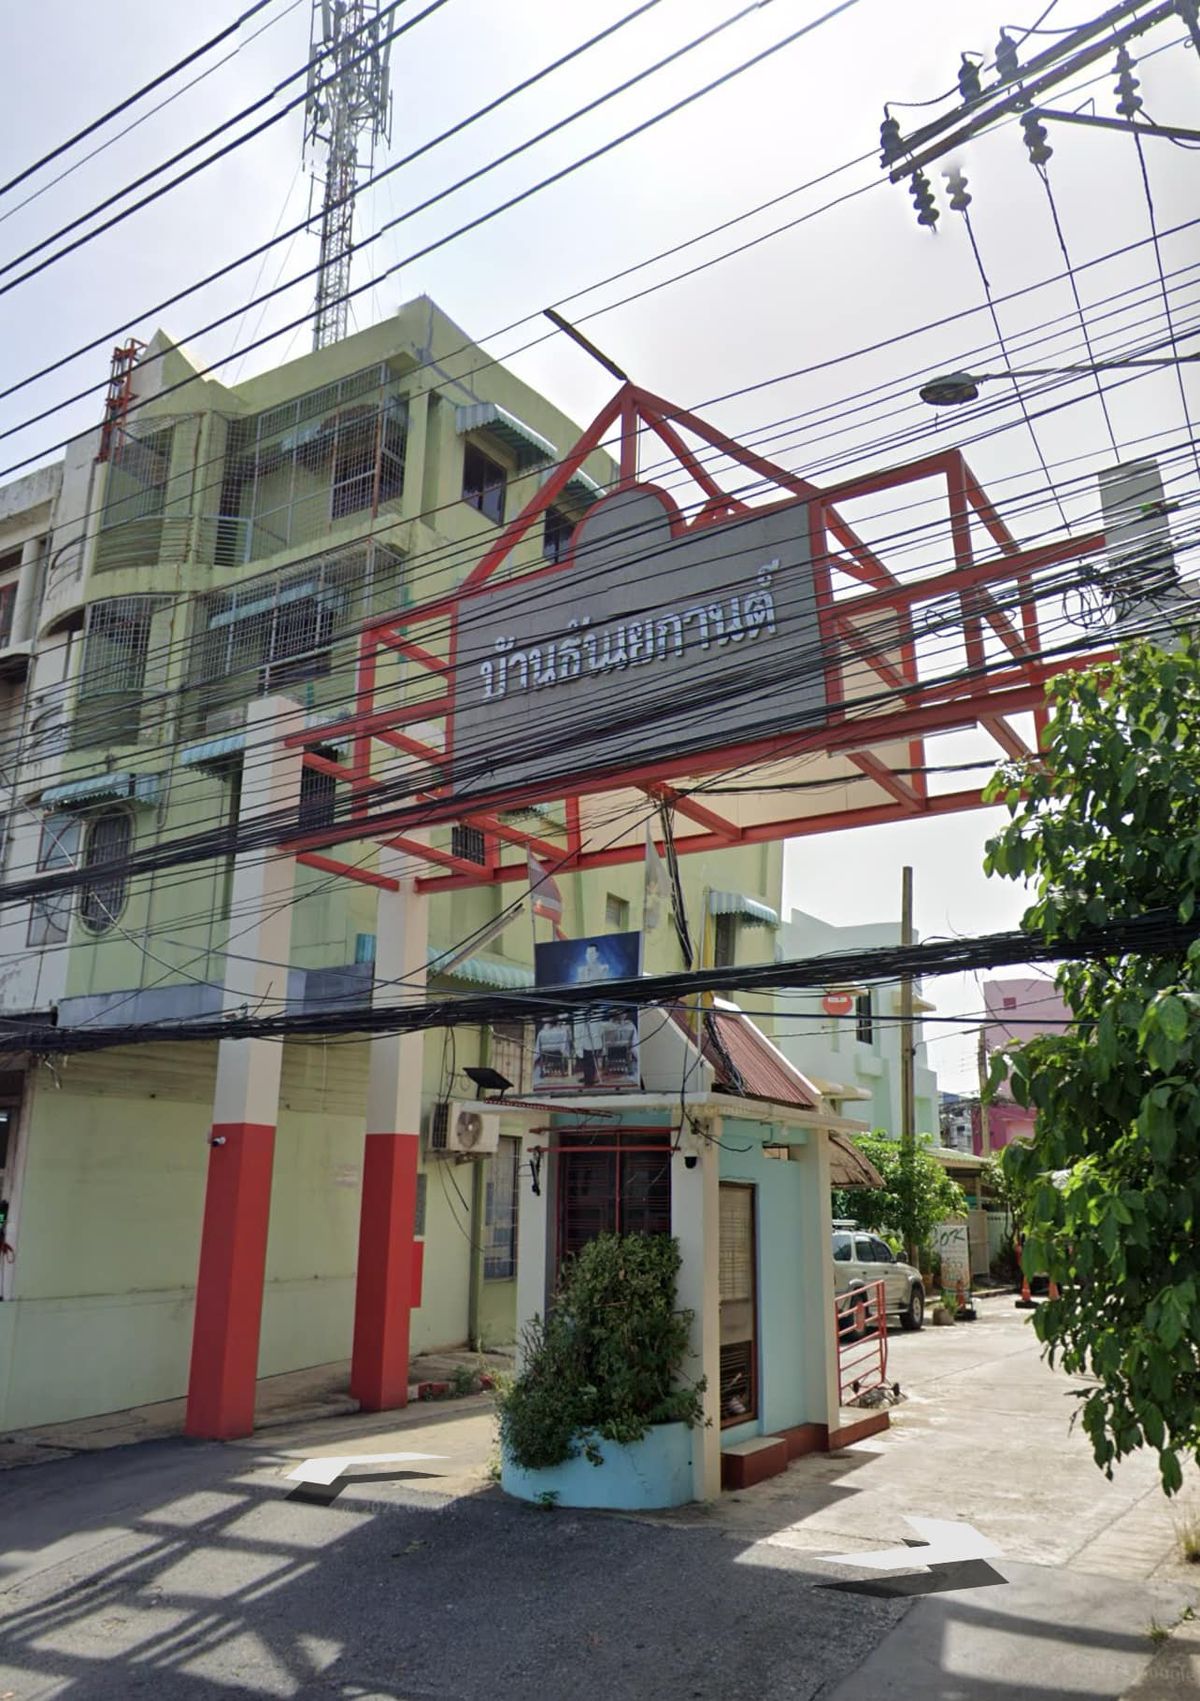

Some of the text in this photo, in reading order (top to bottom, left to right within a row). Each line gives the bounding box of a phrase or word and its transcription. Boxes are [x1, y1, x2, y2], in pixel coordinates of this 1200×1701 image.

[480, 558, 780, 703] บ้านธันยกานต์
